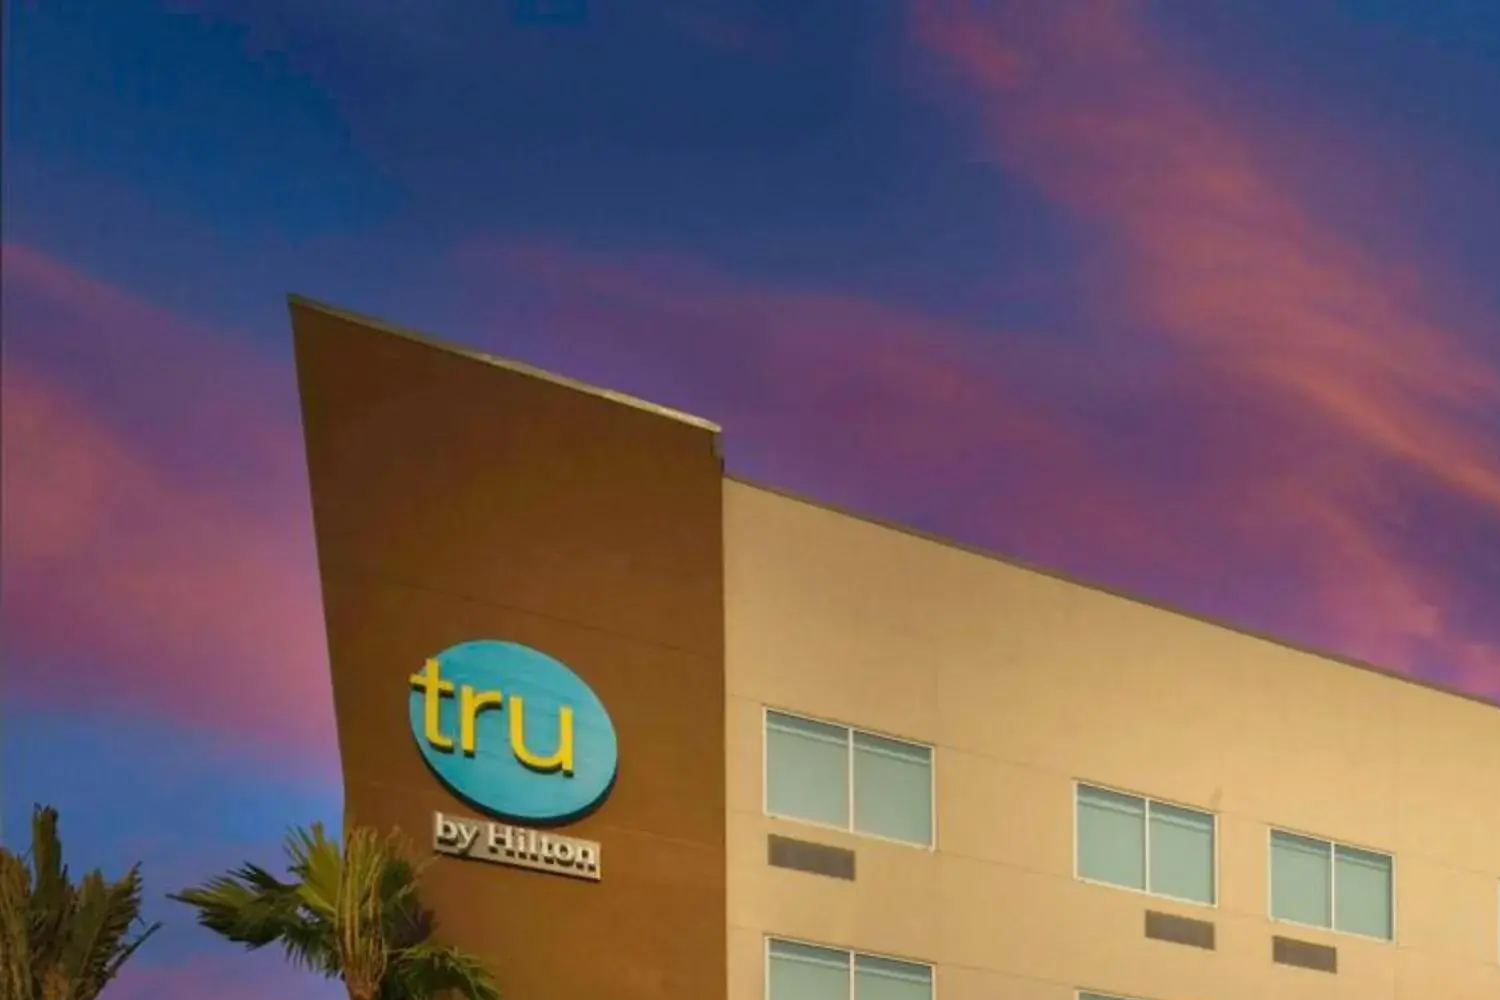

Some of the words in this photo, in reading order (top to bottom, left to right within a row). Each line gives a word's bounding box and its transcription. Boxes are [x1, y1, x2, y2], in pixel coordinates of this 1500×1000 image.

[409, 658, 573, 776] tru
[435, 812, 477, 849] by
[488, 823, 596, 865] Hilton
